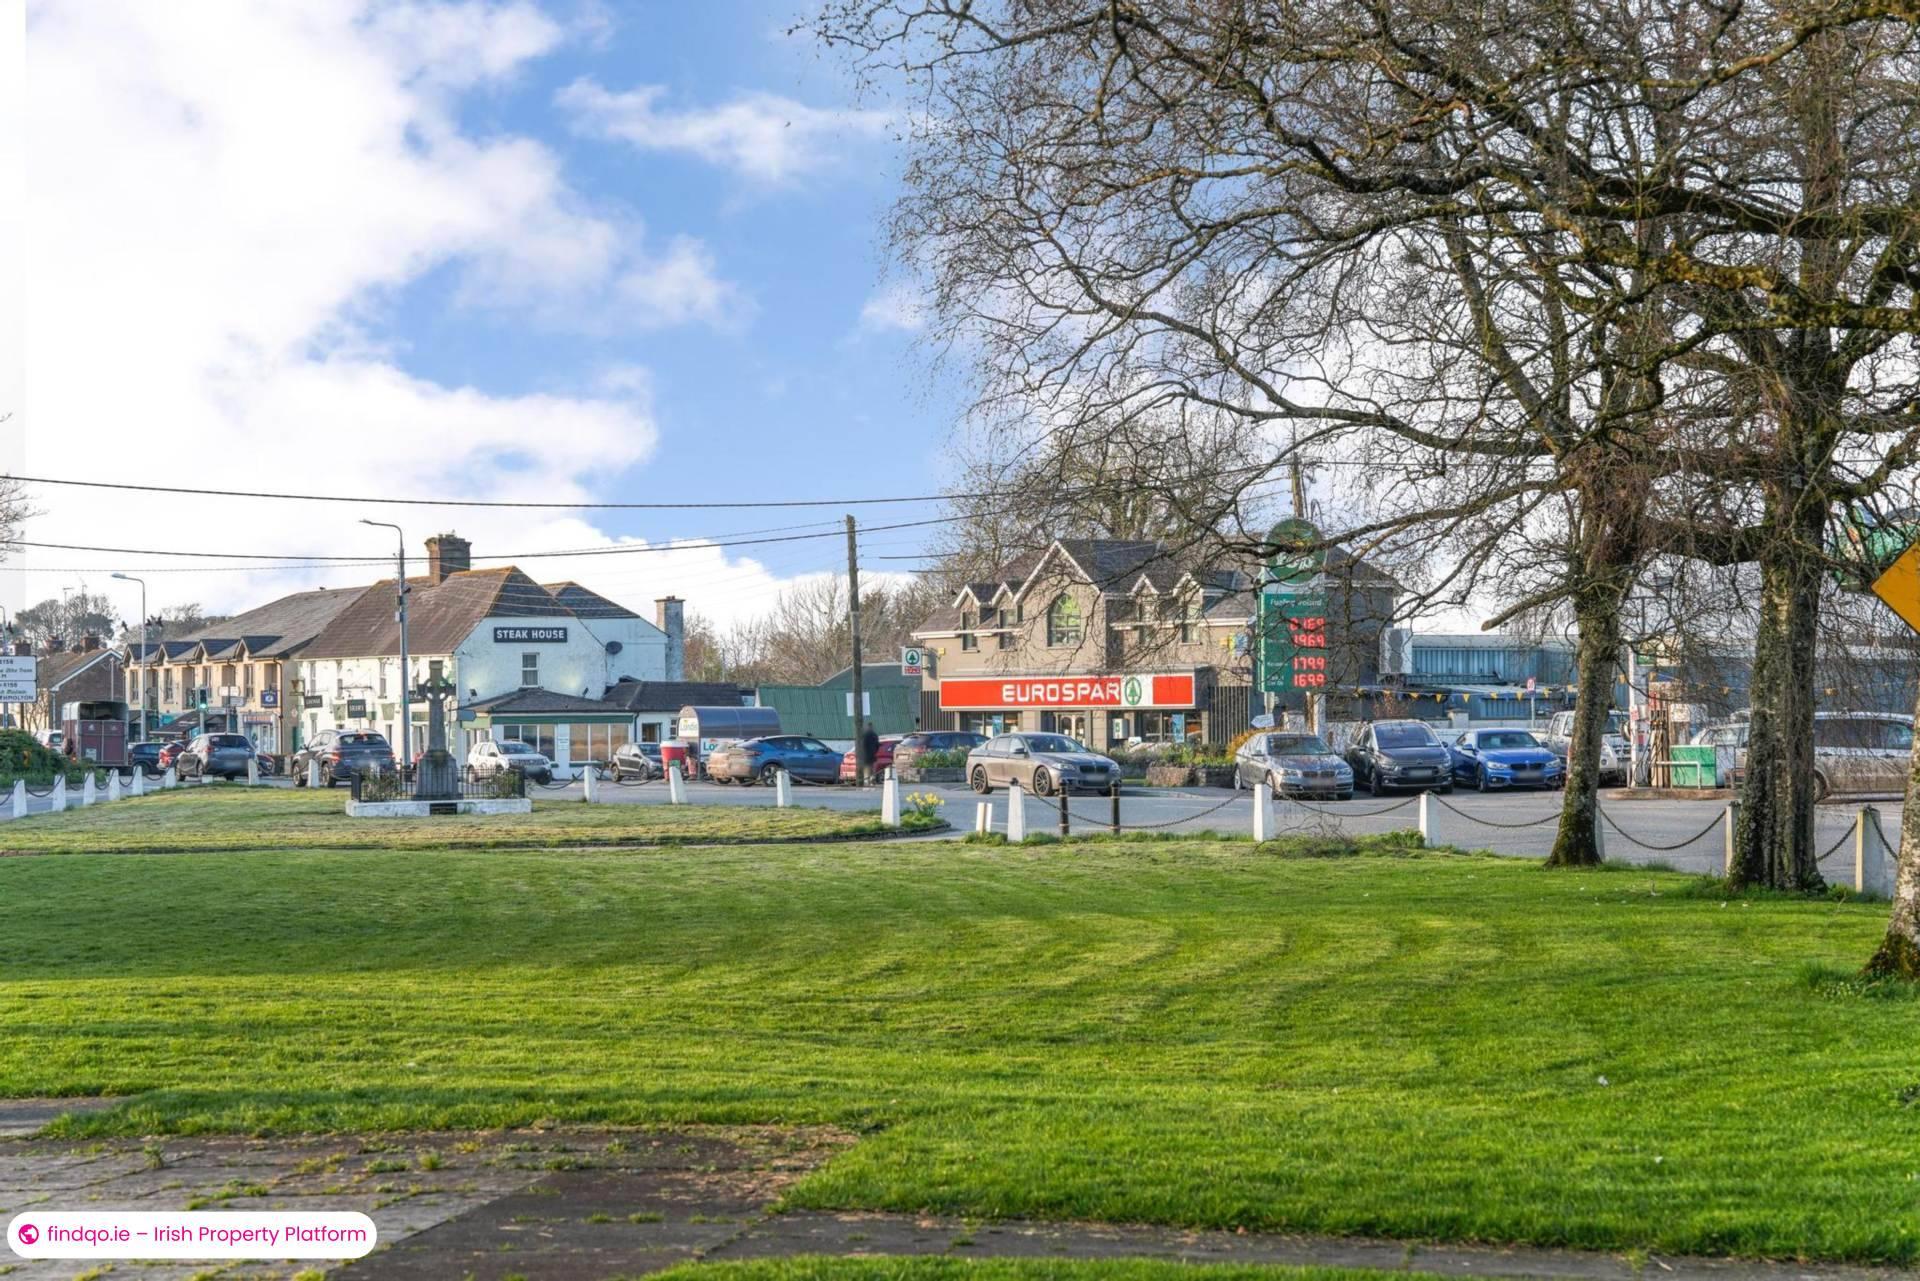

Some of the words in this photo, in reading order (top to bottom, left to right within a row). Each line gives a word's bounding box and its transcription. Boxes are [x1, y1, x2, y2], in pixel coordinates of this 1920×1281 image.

[496, 629, 529, 639] STEAK
[531, 629, 565, 639] HOUSE
[1002, 683, 1121, 702] EUROSPAR
